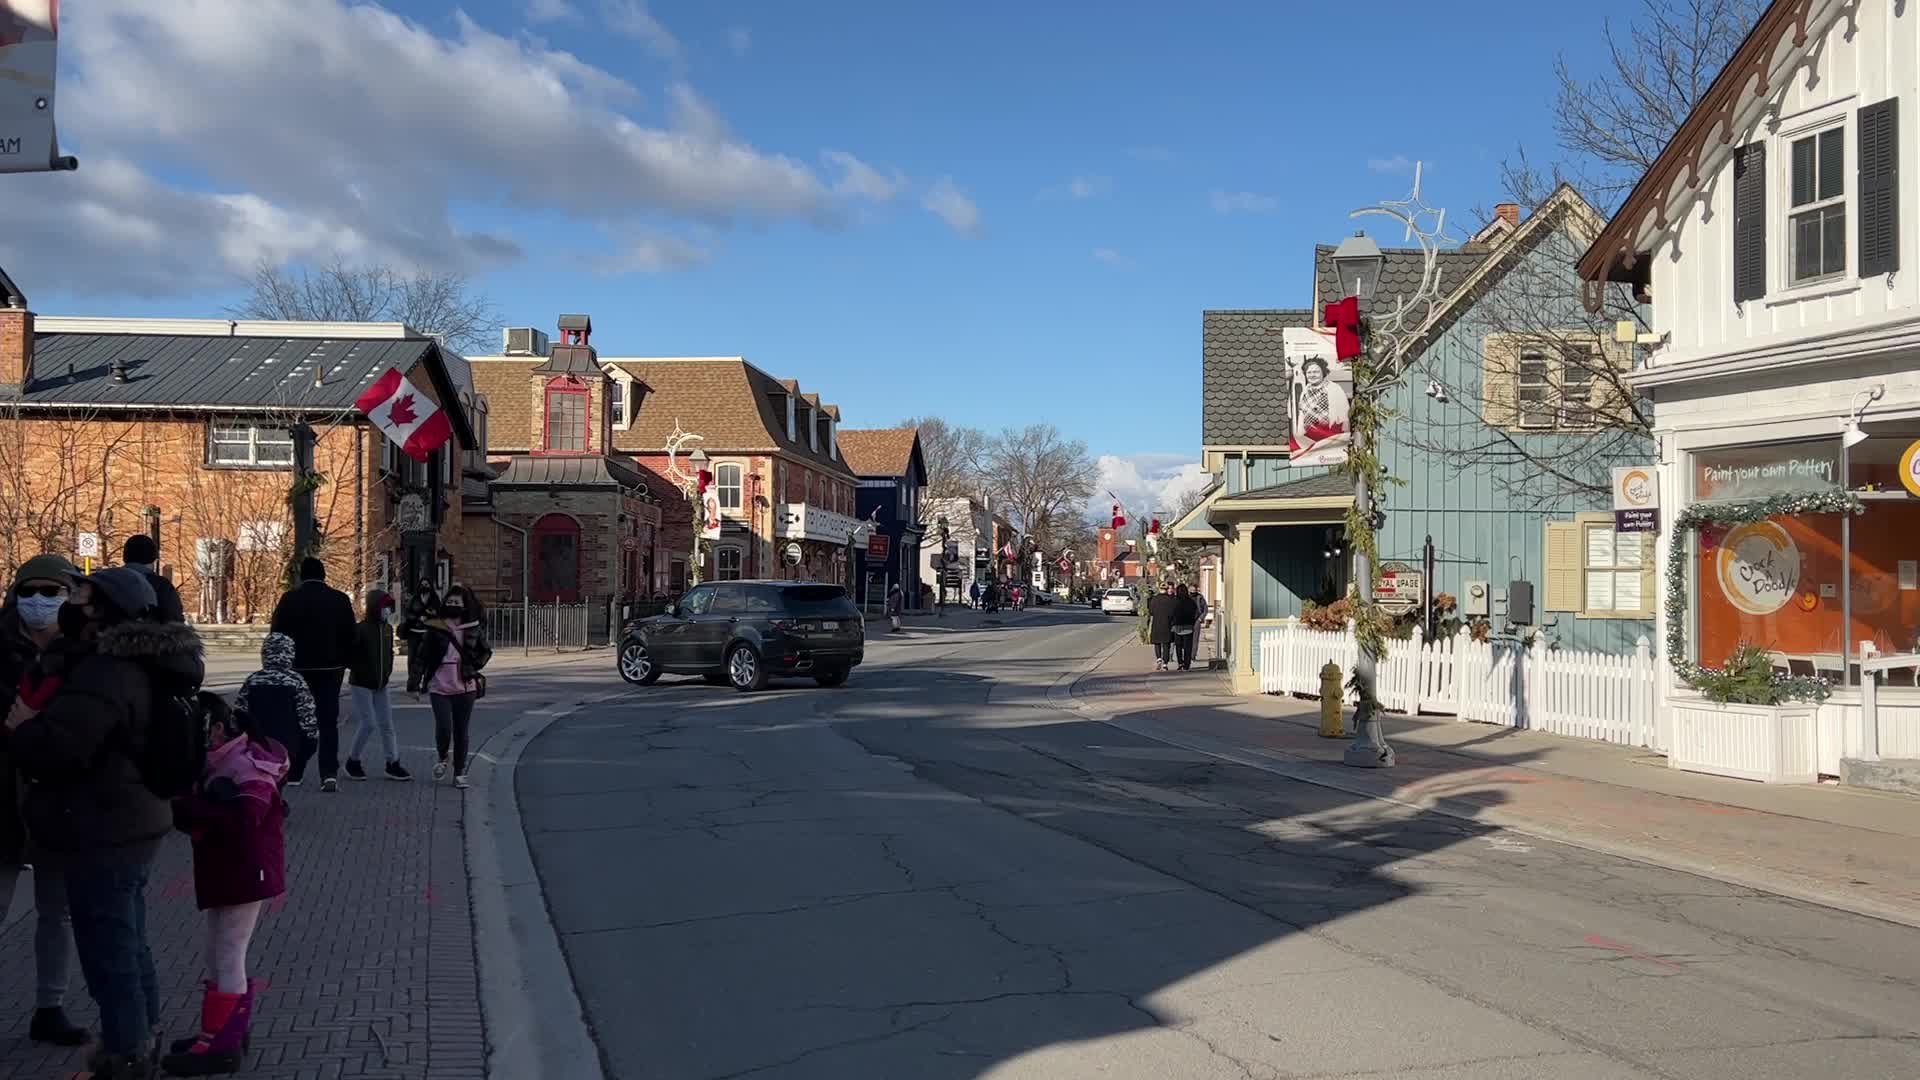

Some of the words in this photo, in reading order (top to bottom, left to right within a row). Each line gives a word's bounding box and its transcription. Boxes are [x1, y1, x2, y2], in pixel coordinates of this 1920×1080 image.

[1704, 464, 1732, 481] Paint
[1735, 466, 1759, 488] your
[1761, 465, 1785, 479] own
[1789, 458, 1834, 481] Pottery
[1740, 550, 1776, 582] Crock
